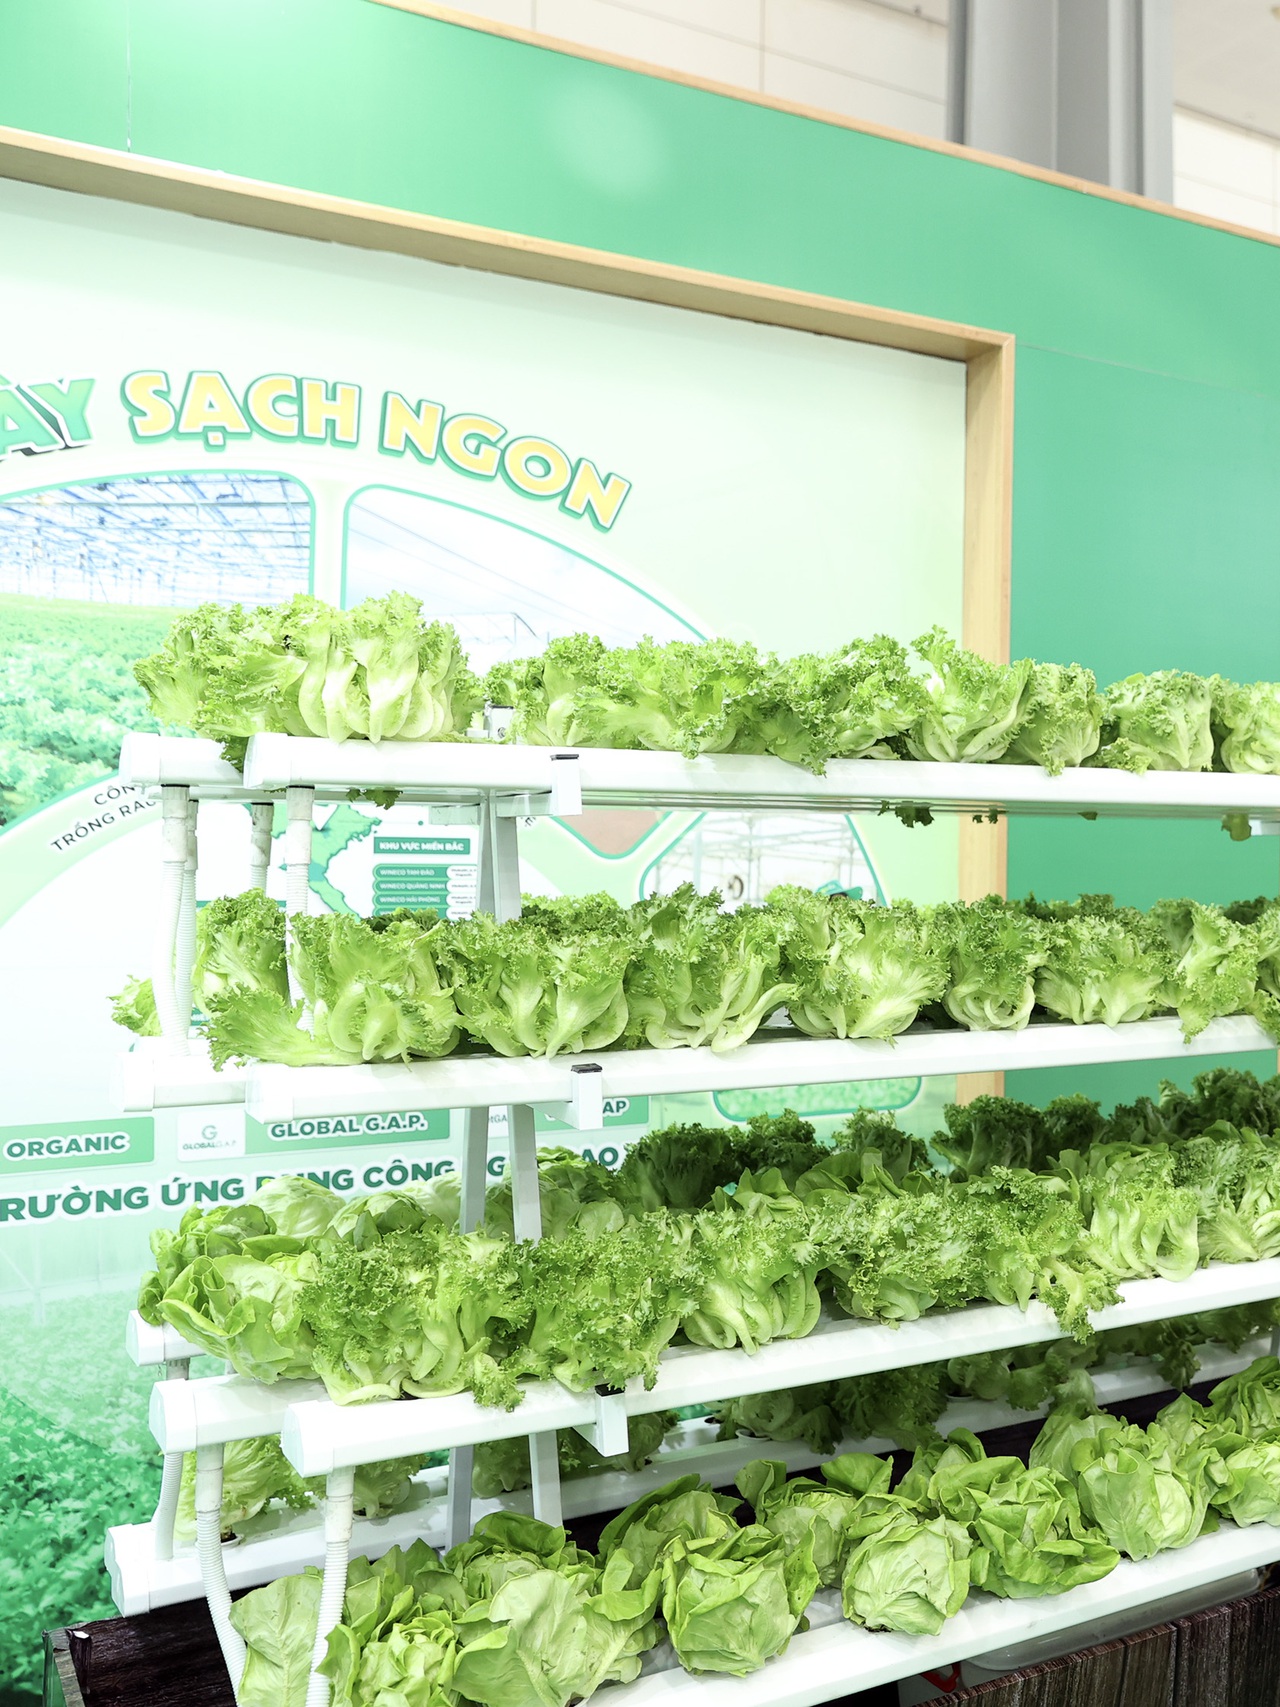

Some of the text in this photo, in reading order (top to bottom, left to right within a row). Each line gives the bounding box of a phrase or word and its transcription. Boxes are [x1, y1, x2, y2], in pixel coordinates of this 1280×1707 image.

[121, 371, 361, 451] SẠCH
[379, 391, 631, 532] NGON
[94, 785, 136, 806] CÔN
[379, 841, 399, 850] KHU
[400, 841, 420, 852] VỰC
[445, 840, 464, 851] BẮC
[271, 1114, 426, 1138] GLOBAL G.A.P.
[7, 1134, 126, 1158] ORGANIC
[161, 1177, 245, 1206] ỨNG
